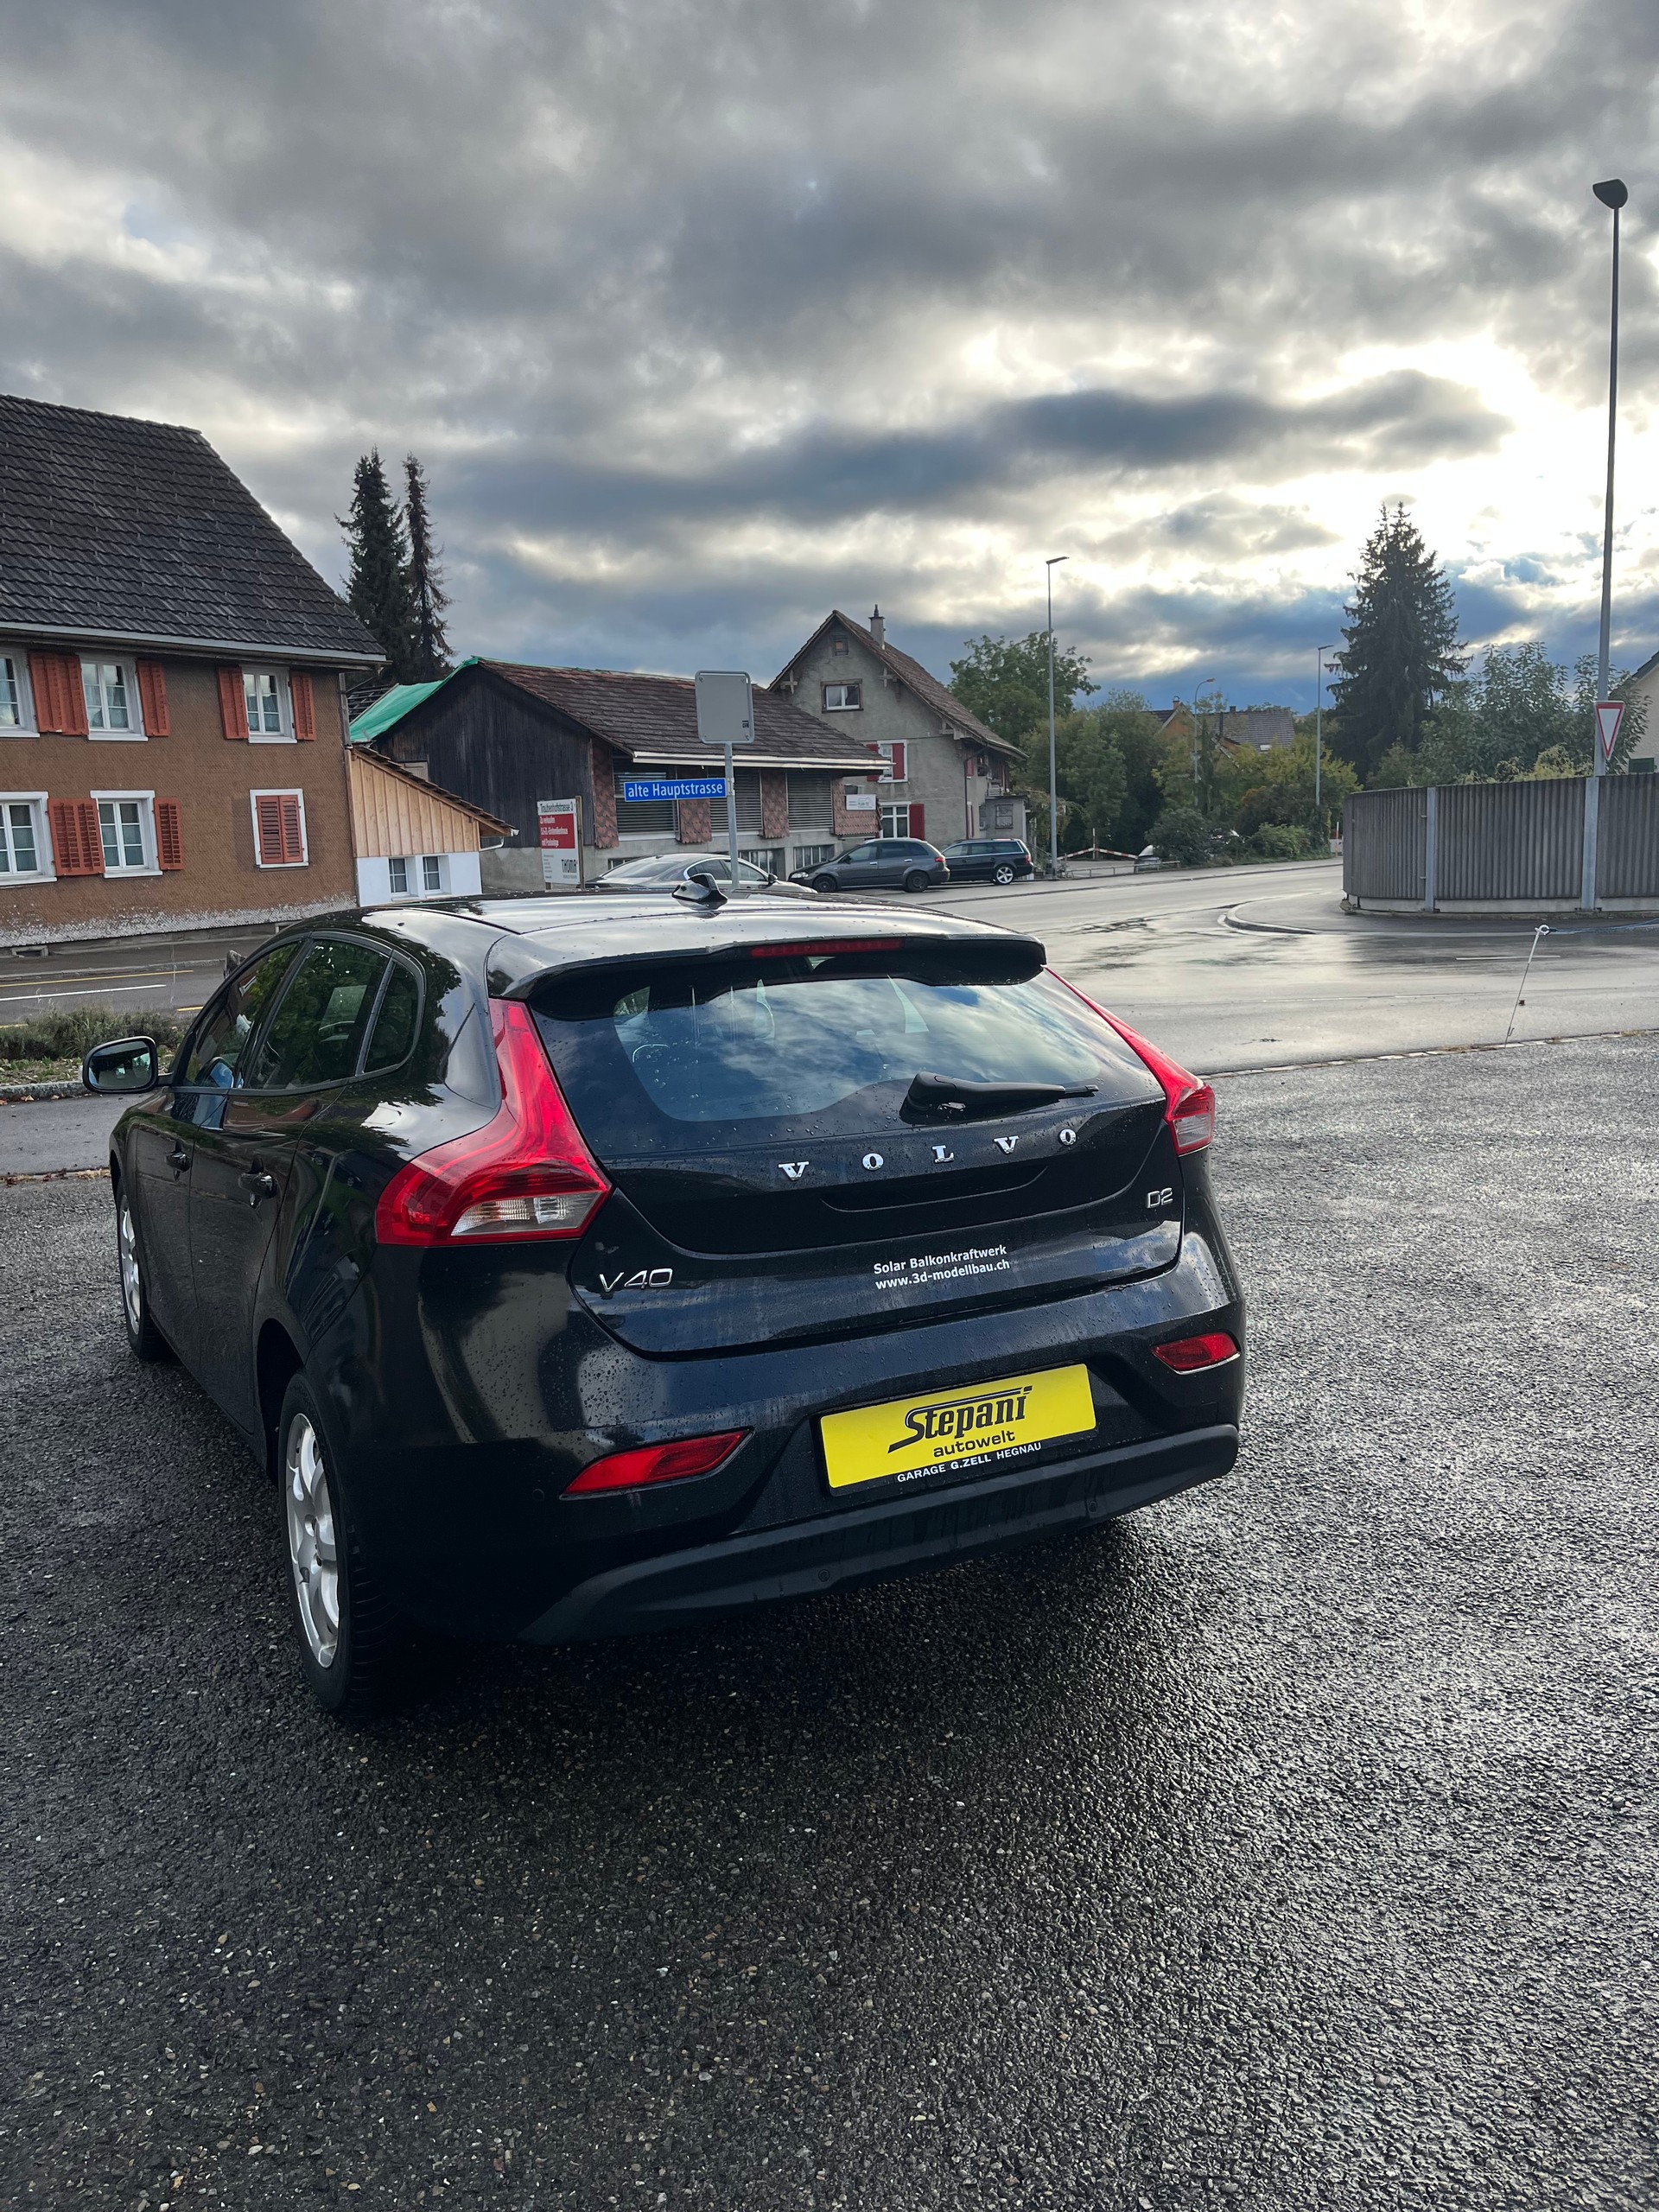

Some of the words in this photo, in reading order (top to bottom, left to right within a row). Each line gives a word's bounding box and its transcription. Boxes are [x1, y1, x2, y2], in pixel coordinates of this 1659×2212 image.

[628, 783, 649, 798] alte
[652, 783, 723, 799] Hauptstrasse
[779, 1129, 1077, 1180] VOLVO
[1147, 1187, 1173, 1209] D2
[874, 1261, 906, 1274] Solar
[910, 1244, 1007, 1268] Balkonkraftwerk
[875, 1259, 1010, 1289] www.3d-modellbau.ch
[599, 1268, 673, 1293] V40
[887, 1385, 1033, 1454] Stepani
[933, 1430, 1015, 1458] autowelt
[897, 1464, 946, 1483] GARAGE
[950, 1454, 992, 1470] G.ZELL
[996, 1442, 1042, 1460] HEGNAU
